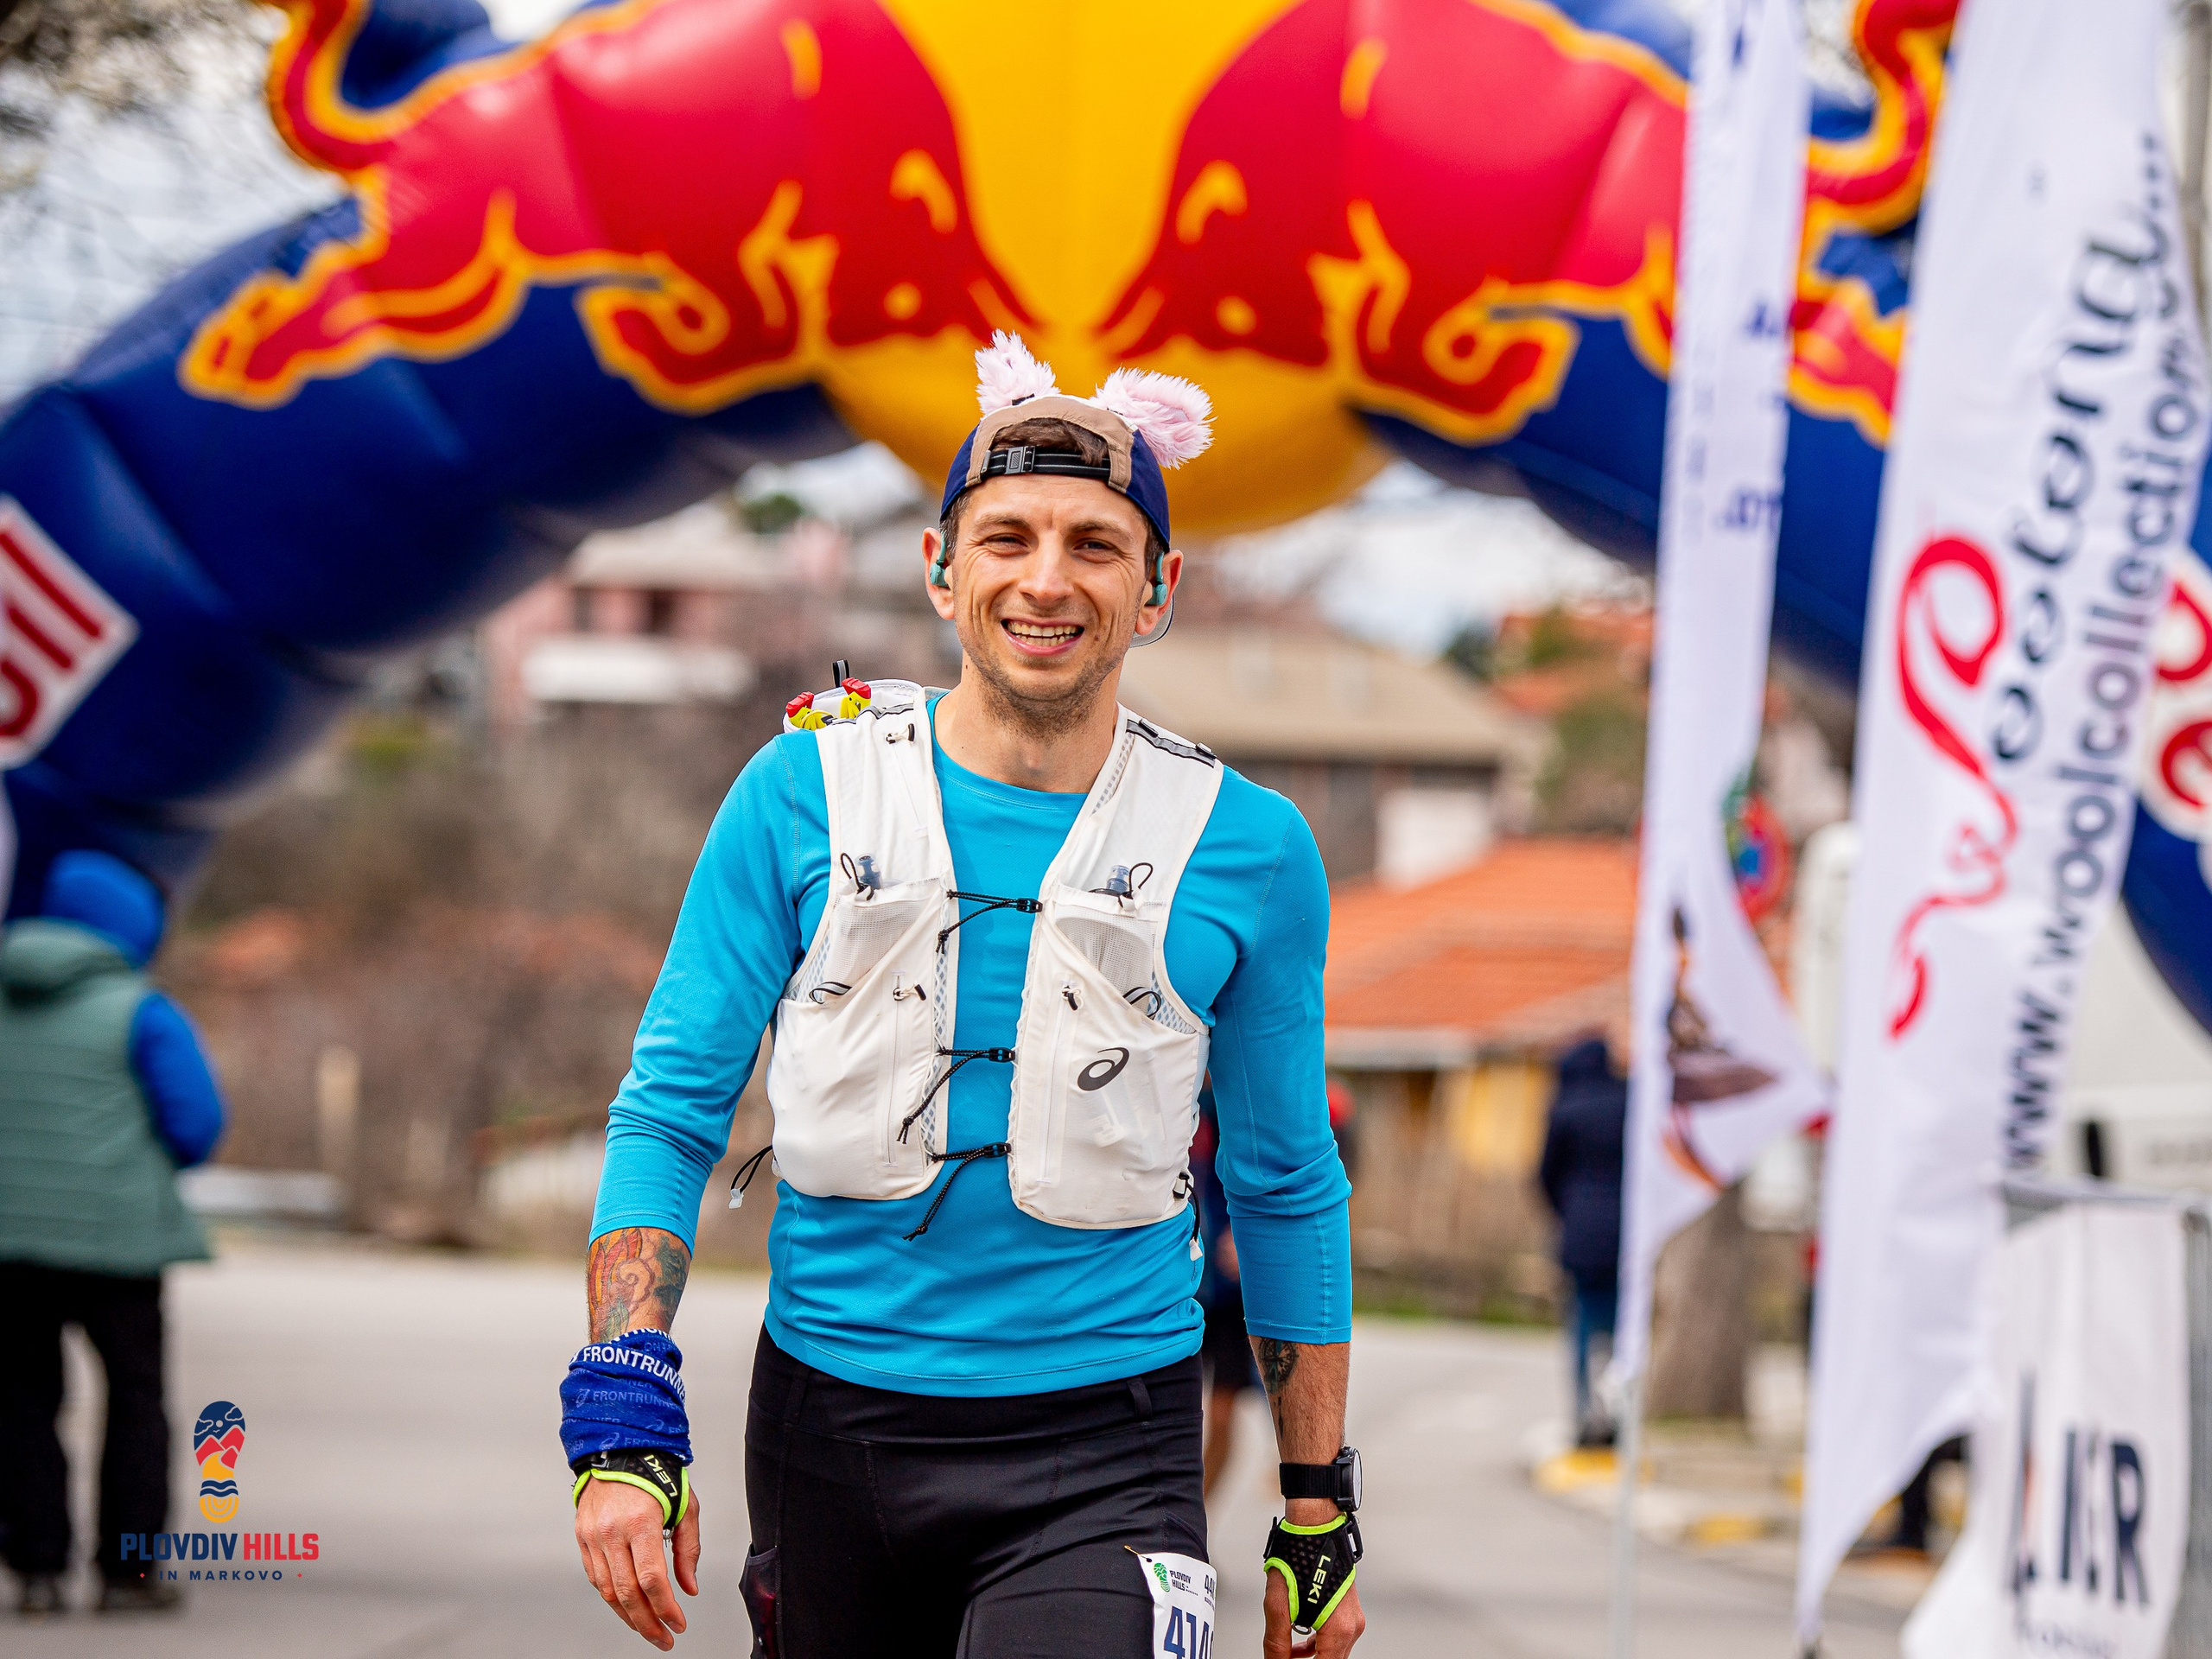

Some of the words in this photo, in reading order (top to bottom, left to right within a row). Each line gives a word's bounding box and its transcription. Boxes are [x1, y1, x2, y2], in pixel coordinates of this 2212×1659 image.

[583, 1345, 685, 1404] FRONTRUNNE
[644, 1454, 678, 1497] LEKI
[1172, 1580, 1185, 1592] HILLS
[1307, 1554, 1331, 1605] LEKI
[1164, 1605, 1214, 1659] 414
